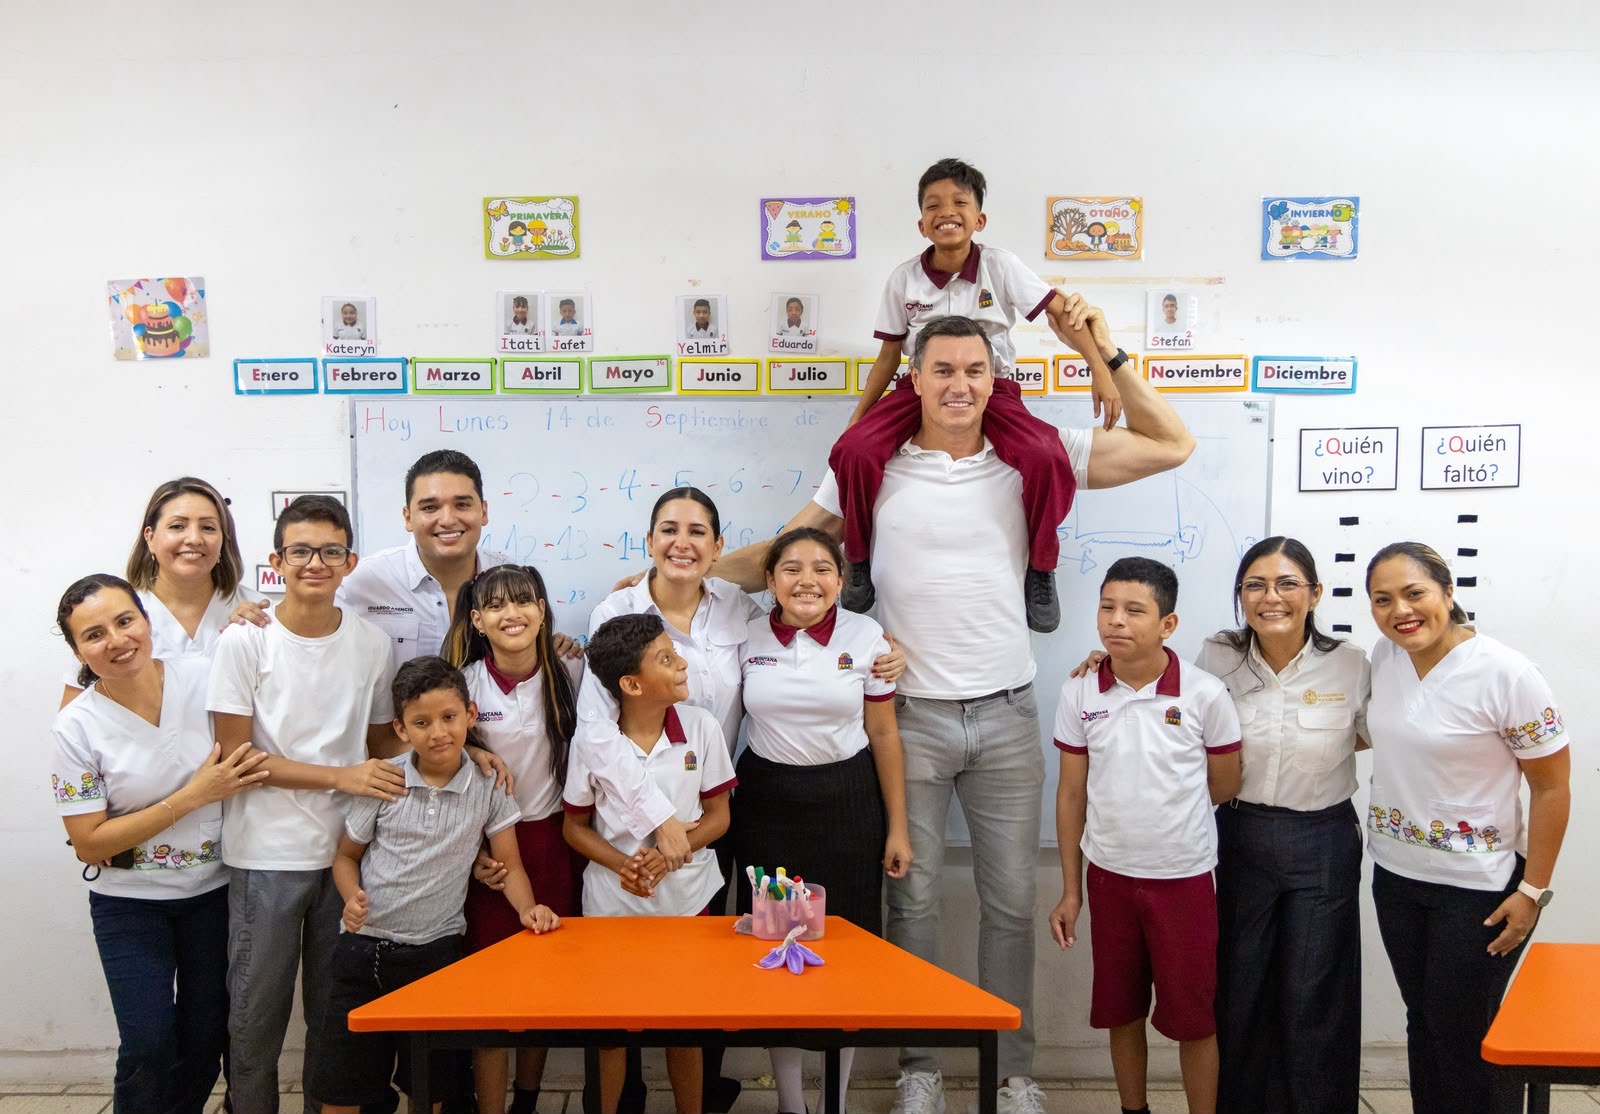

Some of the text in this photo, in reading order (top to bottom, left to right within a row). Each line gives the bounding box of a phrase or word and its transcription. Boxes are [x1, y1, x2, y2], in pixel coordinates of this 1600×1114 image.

[510, 211, 569, 220] PRIMAVERA
[787, 209, 832, 219] VERANO
[1089, 207, 1130, 218] OTOÑO
[1290, 209, 1342, 218] INVIERNO
[501, 338, 541, 350] Itati
[552, 339, 586, 350] Jafet
[677, 342, 727, 354] Yelmir
[771, 338, 814, 350] Eduardo
[1151, 336, 1191, 347] Stefan
[326, 344, 375, 357] Kateryn
[252, 368, 299, 381] Enero
[332, 367, 397, 381] Febrero
[427, 367, 481, 381] Marzo
[521, 366, 562, 380] Abril
[605, 366, 654, 383] Mayo
[697, 368, 742, 382] Junio
[788, 366, 828, 381] Julio
[1151, 364, 1242, 378] Noviembre
[1264, 365, 1347, 381] Diciembre
[365, 407, 411, 441] Hoy
[439, 405, 509, 432] Lunes
[546, 406, 572, 431] 14
[587, 406, 615, 429] de
[795, 406, 819, 426] de
[1314, 436, 1384, 457] ¿Quién
[1436, 434, 1506, 455] ¿Quién
[1322, 466, 1374, 484] vino?
[1444, 463, 1499, 483] faltó?
[571, 471, 588, 513] 3
[618, 469, 642, 500] 4
[728, 467, 746, 493] 6
[786, 470, 803, 495] 7
[557, 525, 591, 561] 13
